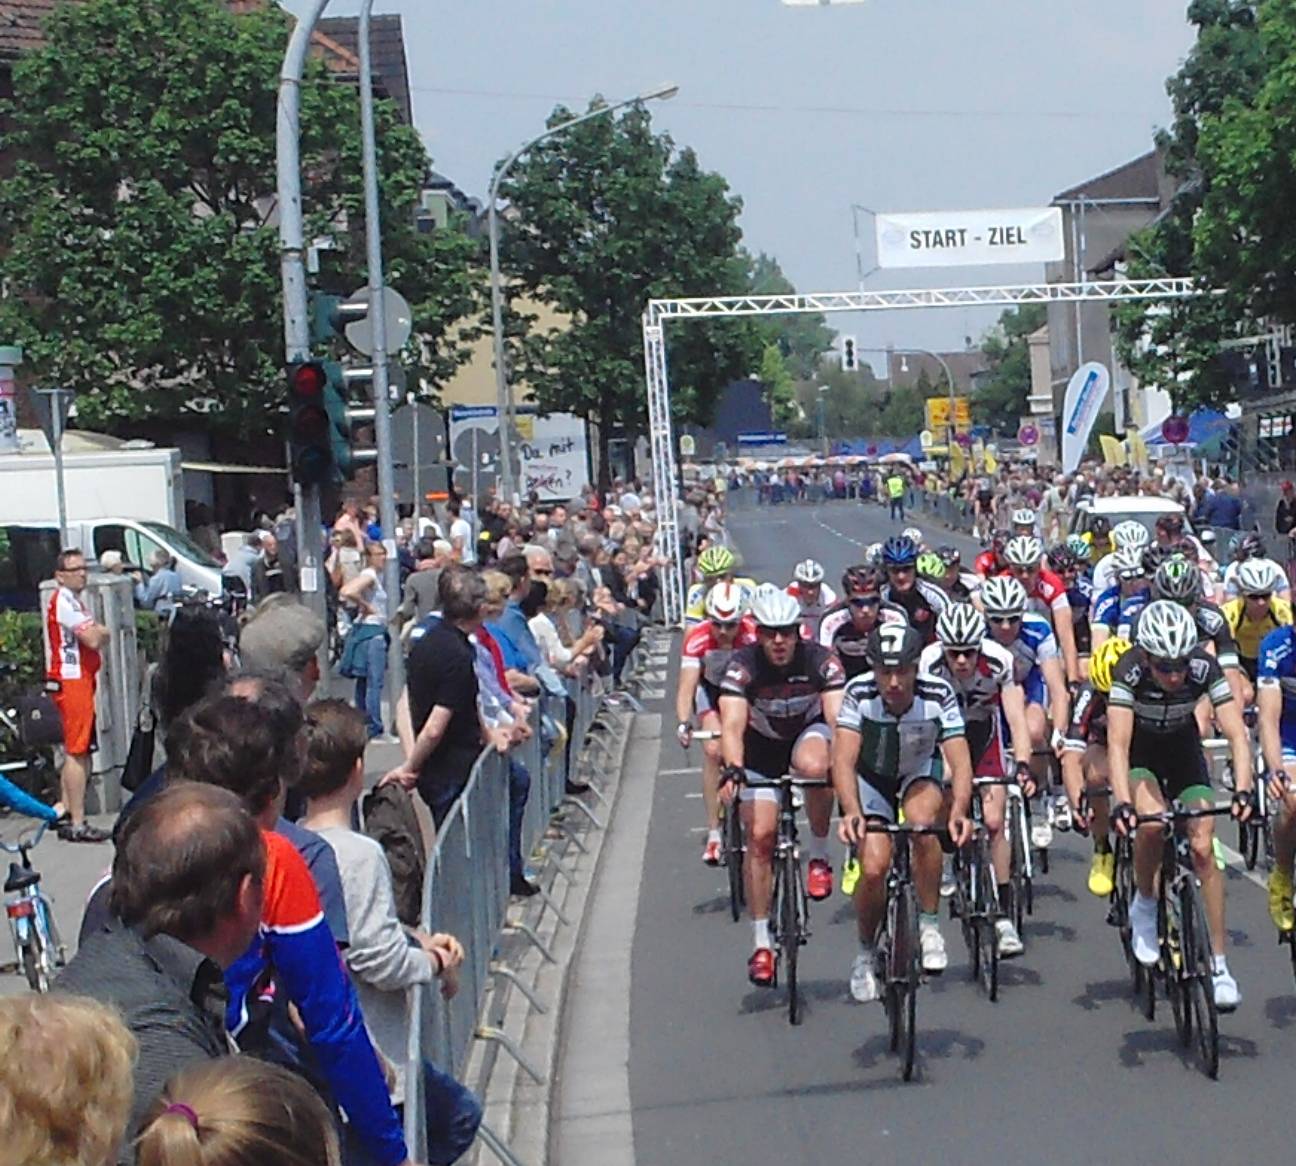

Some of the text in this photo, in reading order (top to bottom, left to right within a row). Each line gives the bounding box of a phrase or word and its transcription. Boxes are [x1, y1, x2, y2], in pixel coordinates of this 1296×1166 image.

[910, 229, 967, 249] START
[988, 226, 1027, 246] ZIEL
[521, 437, 574, 460] Da mit
